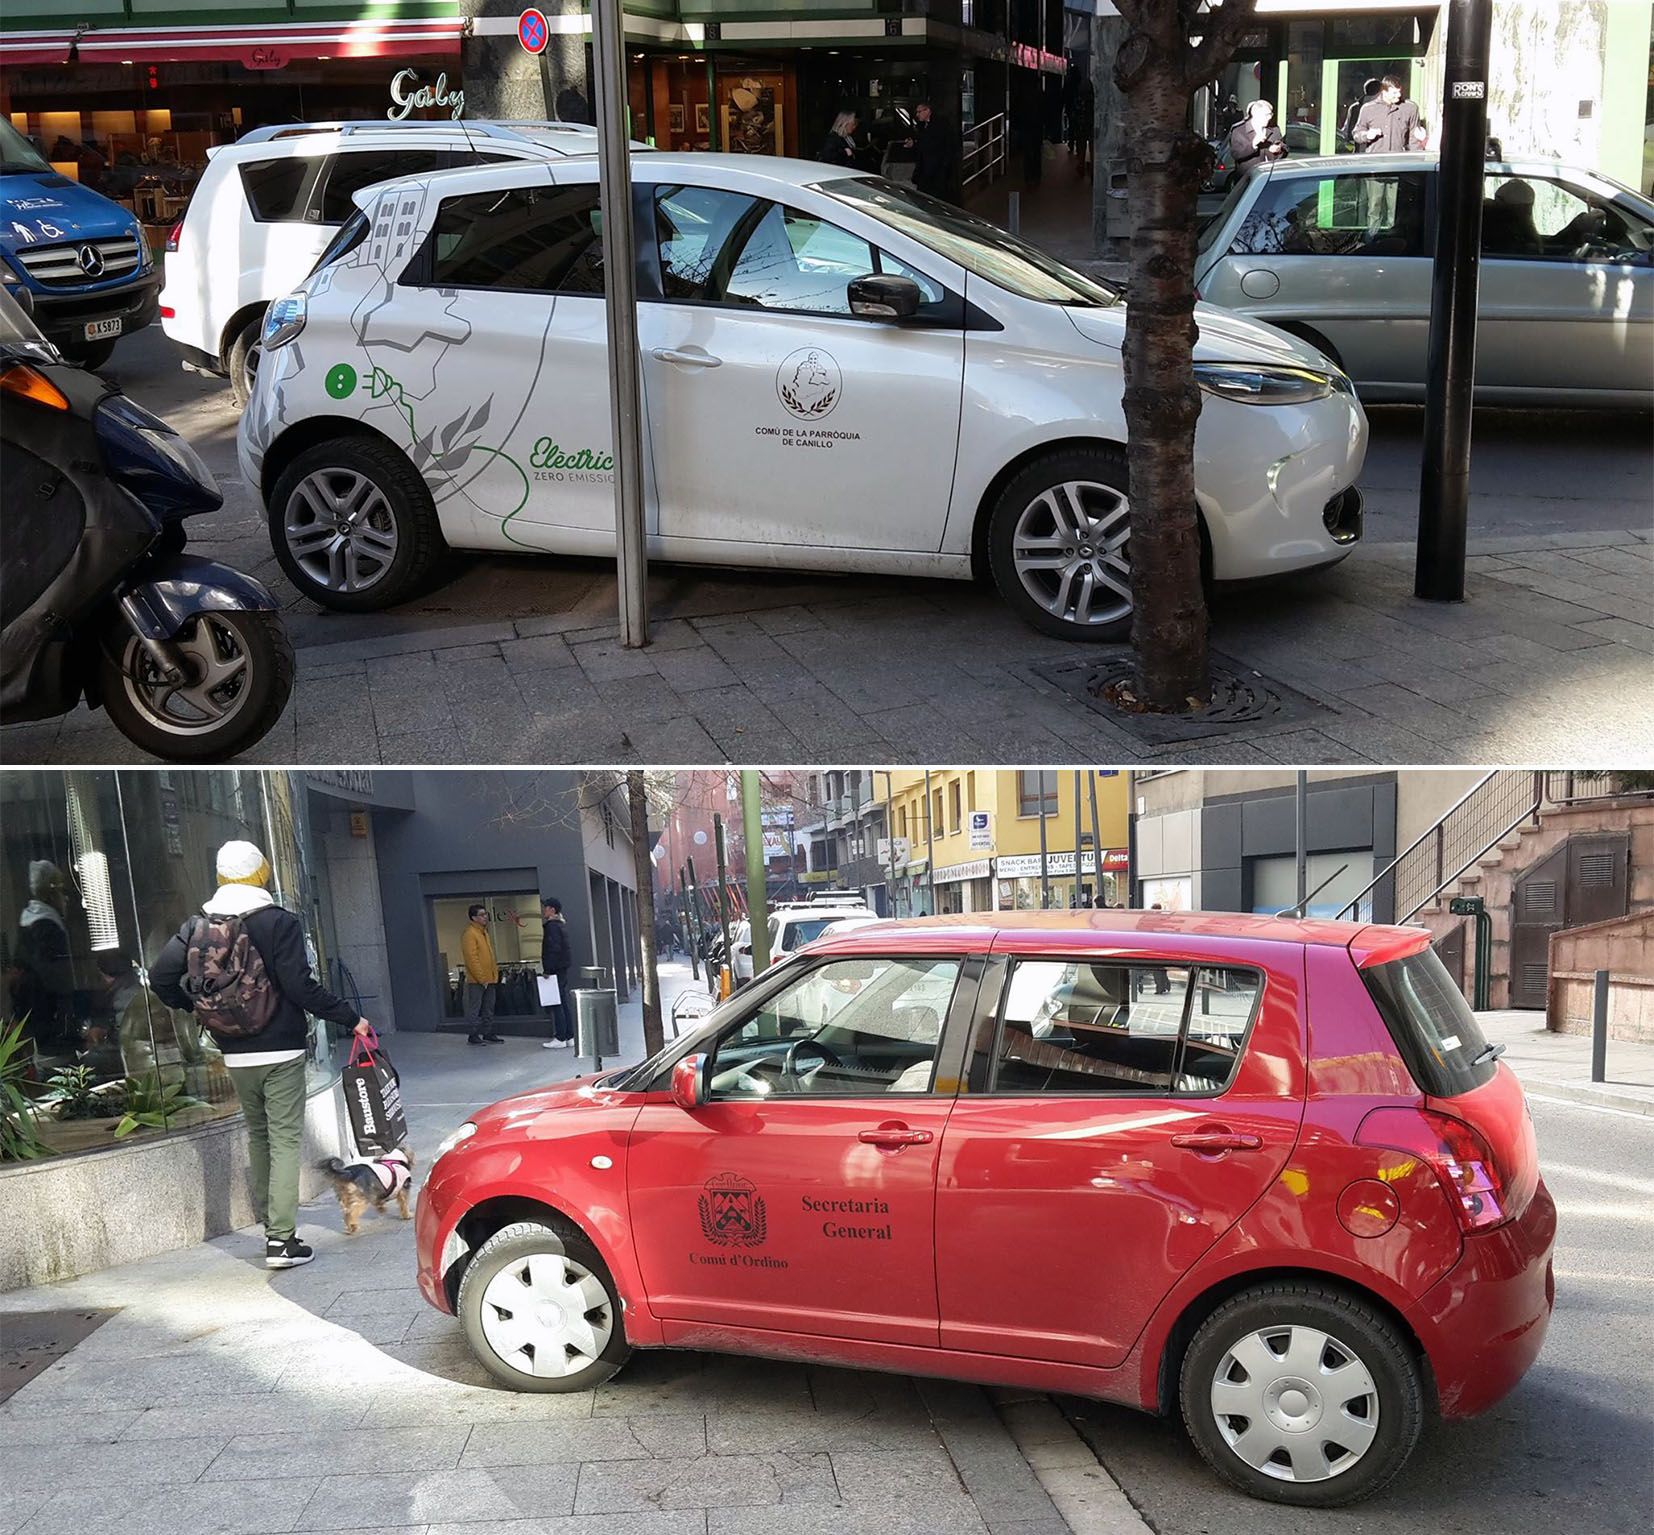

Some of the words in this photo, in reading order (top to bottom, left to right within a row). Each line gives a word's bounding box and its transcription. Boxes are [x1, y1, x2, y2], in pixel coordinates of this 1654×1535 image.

[387, 68, 464, 121] Gaby
[782, 429, 794, 437] DE
[796, 430, 807, 438] LA
[782, 438, 793, 446] DE
[796, 440, 833, 448] CANILLO
[534, 472, 564, 482] ZERO
[356, 1078, 376, 1135] Baustore
[802, 1196, 889, 1213] Secretaria
[823, 1222, 892, 1240] General
[730, 1255, 789, 1269] d'Ordino
